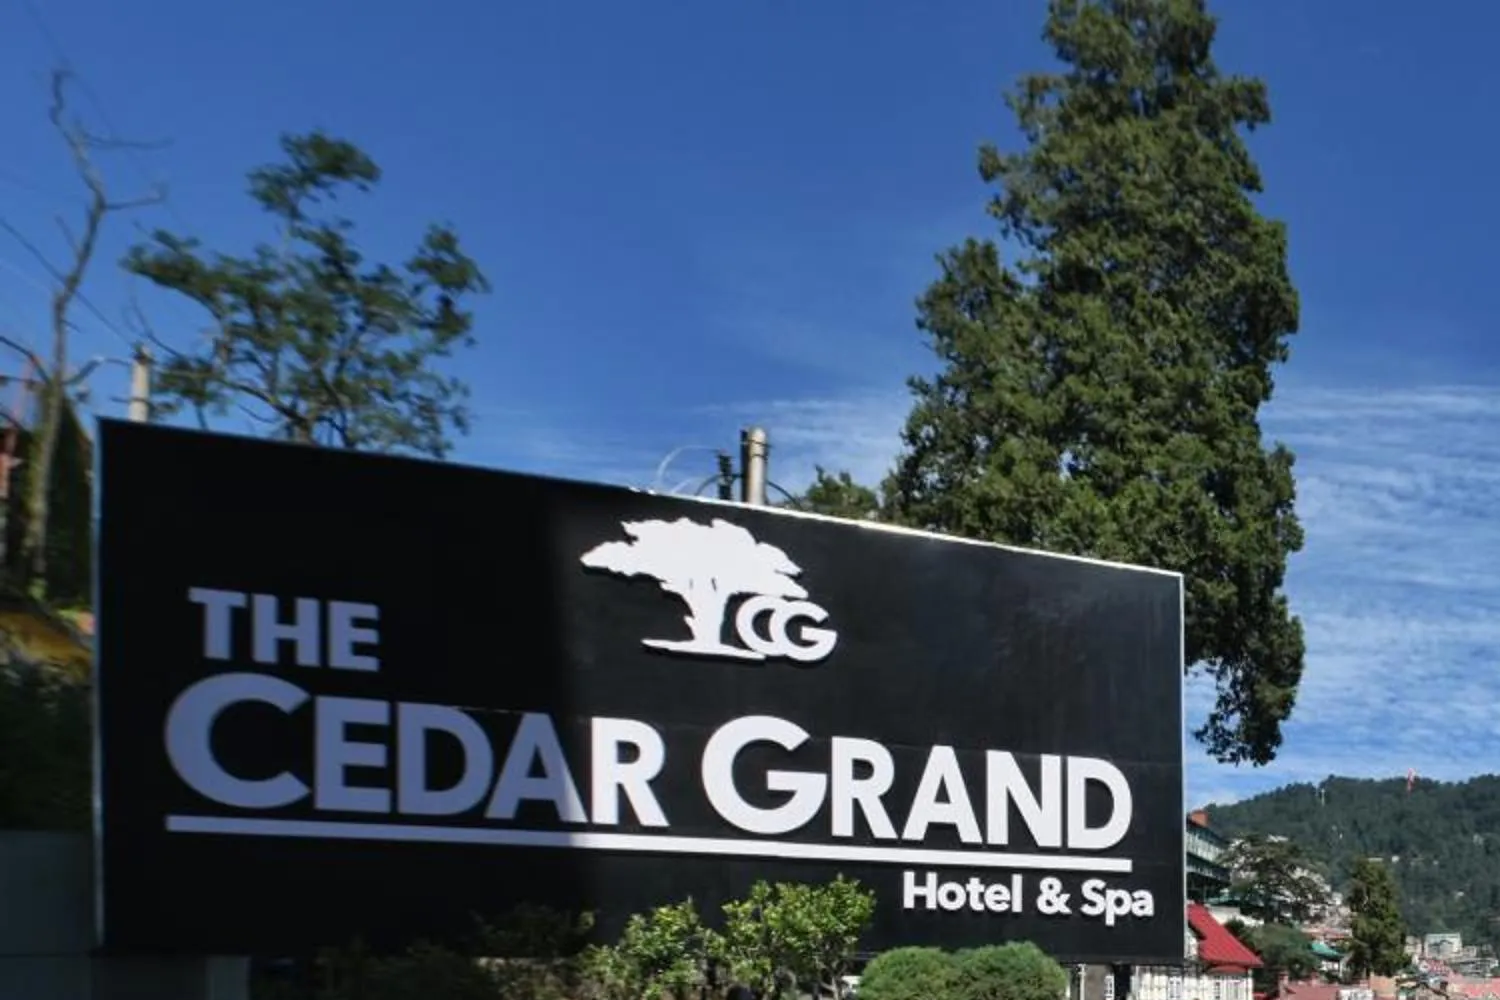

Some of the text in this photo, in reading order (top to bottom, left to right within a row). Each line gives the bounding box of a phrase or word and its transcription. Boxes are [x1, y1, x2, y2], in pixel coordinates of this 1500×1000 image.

[189, 588, 379, 672] THE
[165, 672, 1133, 851] CEDAR GRAND
[903, 871, 1155, 927] Hotel & Spa
